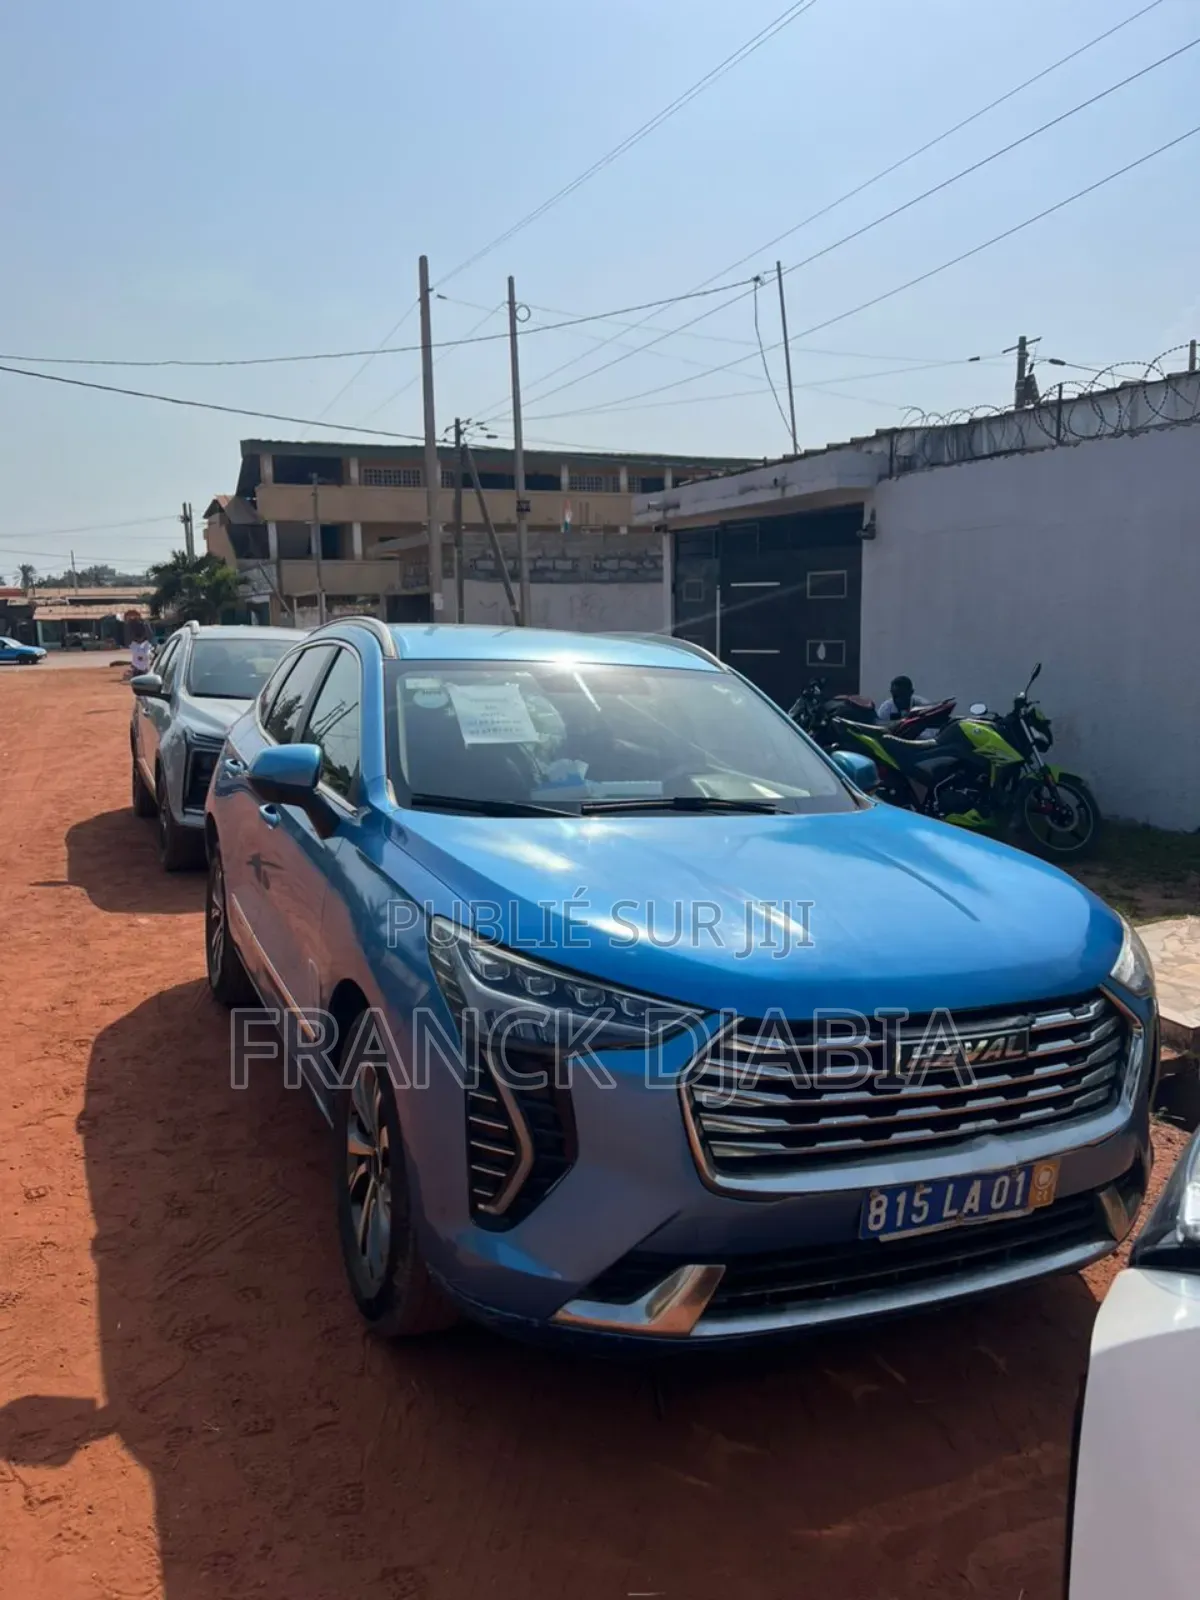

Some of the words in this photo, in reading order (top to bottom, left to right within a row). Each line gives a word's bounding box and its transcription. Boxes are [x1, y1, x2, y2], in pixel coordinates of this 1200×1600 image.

[867, 1186, 933, 1231] 815
[942, 1179, 982, 1218] LA
[990, 1170, 1027, 1209] 01
